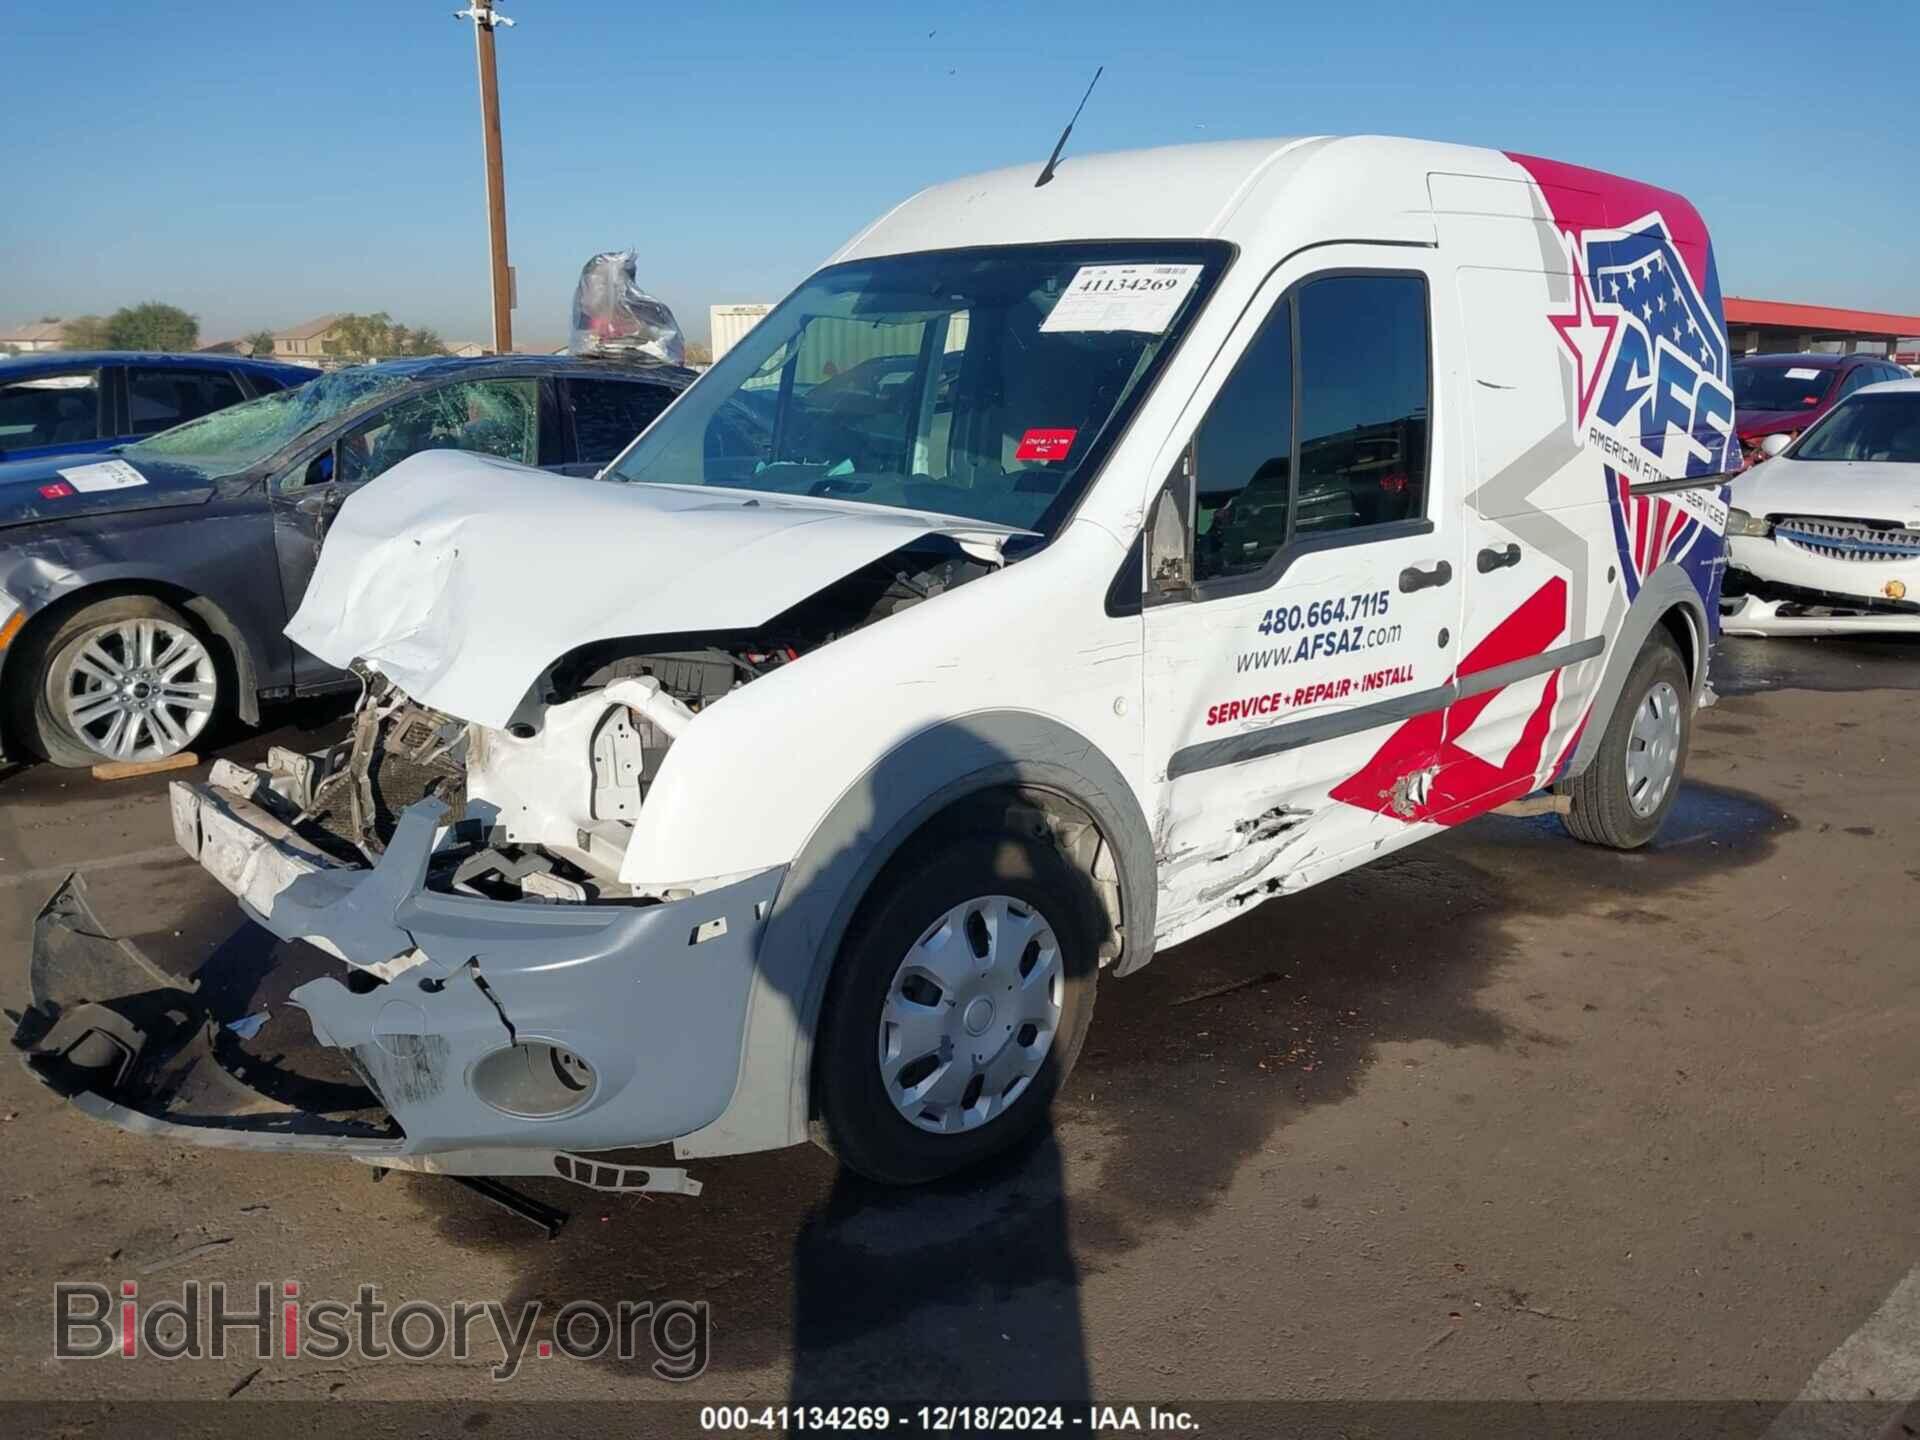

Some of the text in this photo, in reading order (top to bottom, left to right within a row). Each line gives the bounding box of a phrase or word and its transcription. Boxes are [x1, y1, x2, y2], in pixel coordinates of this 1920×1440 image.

[1080, 278, 1178, 292] 41134269
[1596, 323, 1733, 477] AFS
[1589, 427, 1640, 473] AMERICAN
[1685, 491, 1726, 526] SERVICES
[1258, 590, 1390, 635] 480.664.7115
[1236, 624, 1402, 673] www.AFSAZ.com
[1206, 664, 1414, 726] SERVICE REPAIR INSTALL
